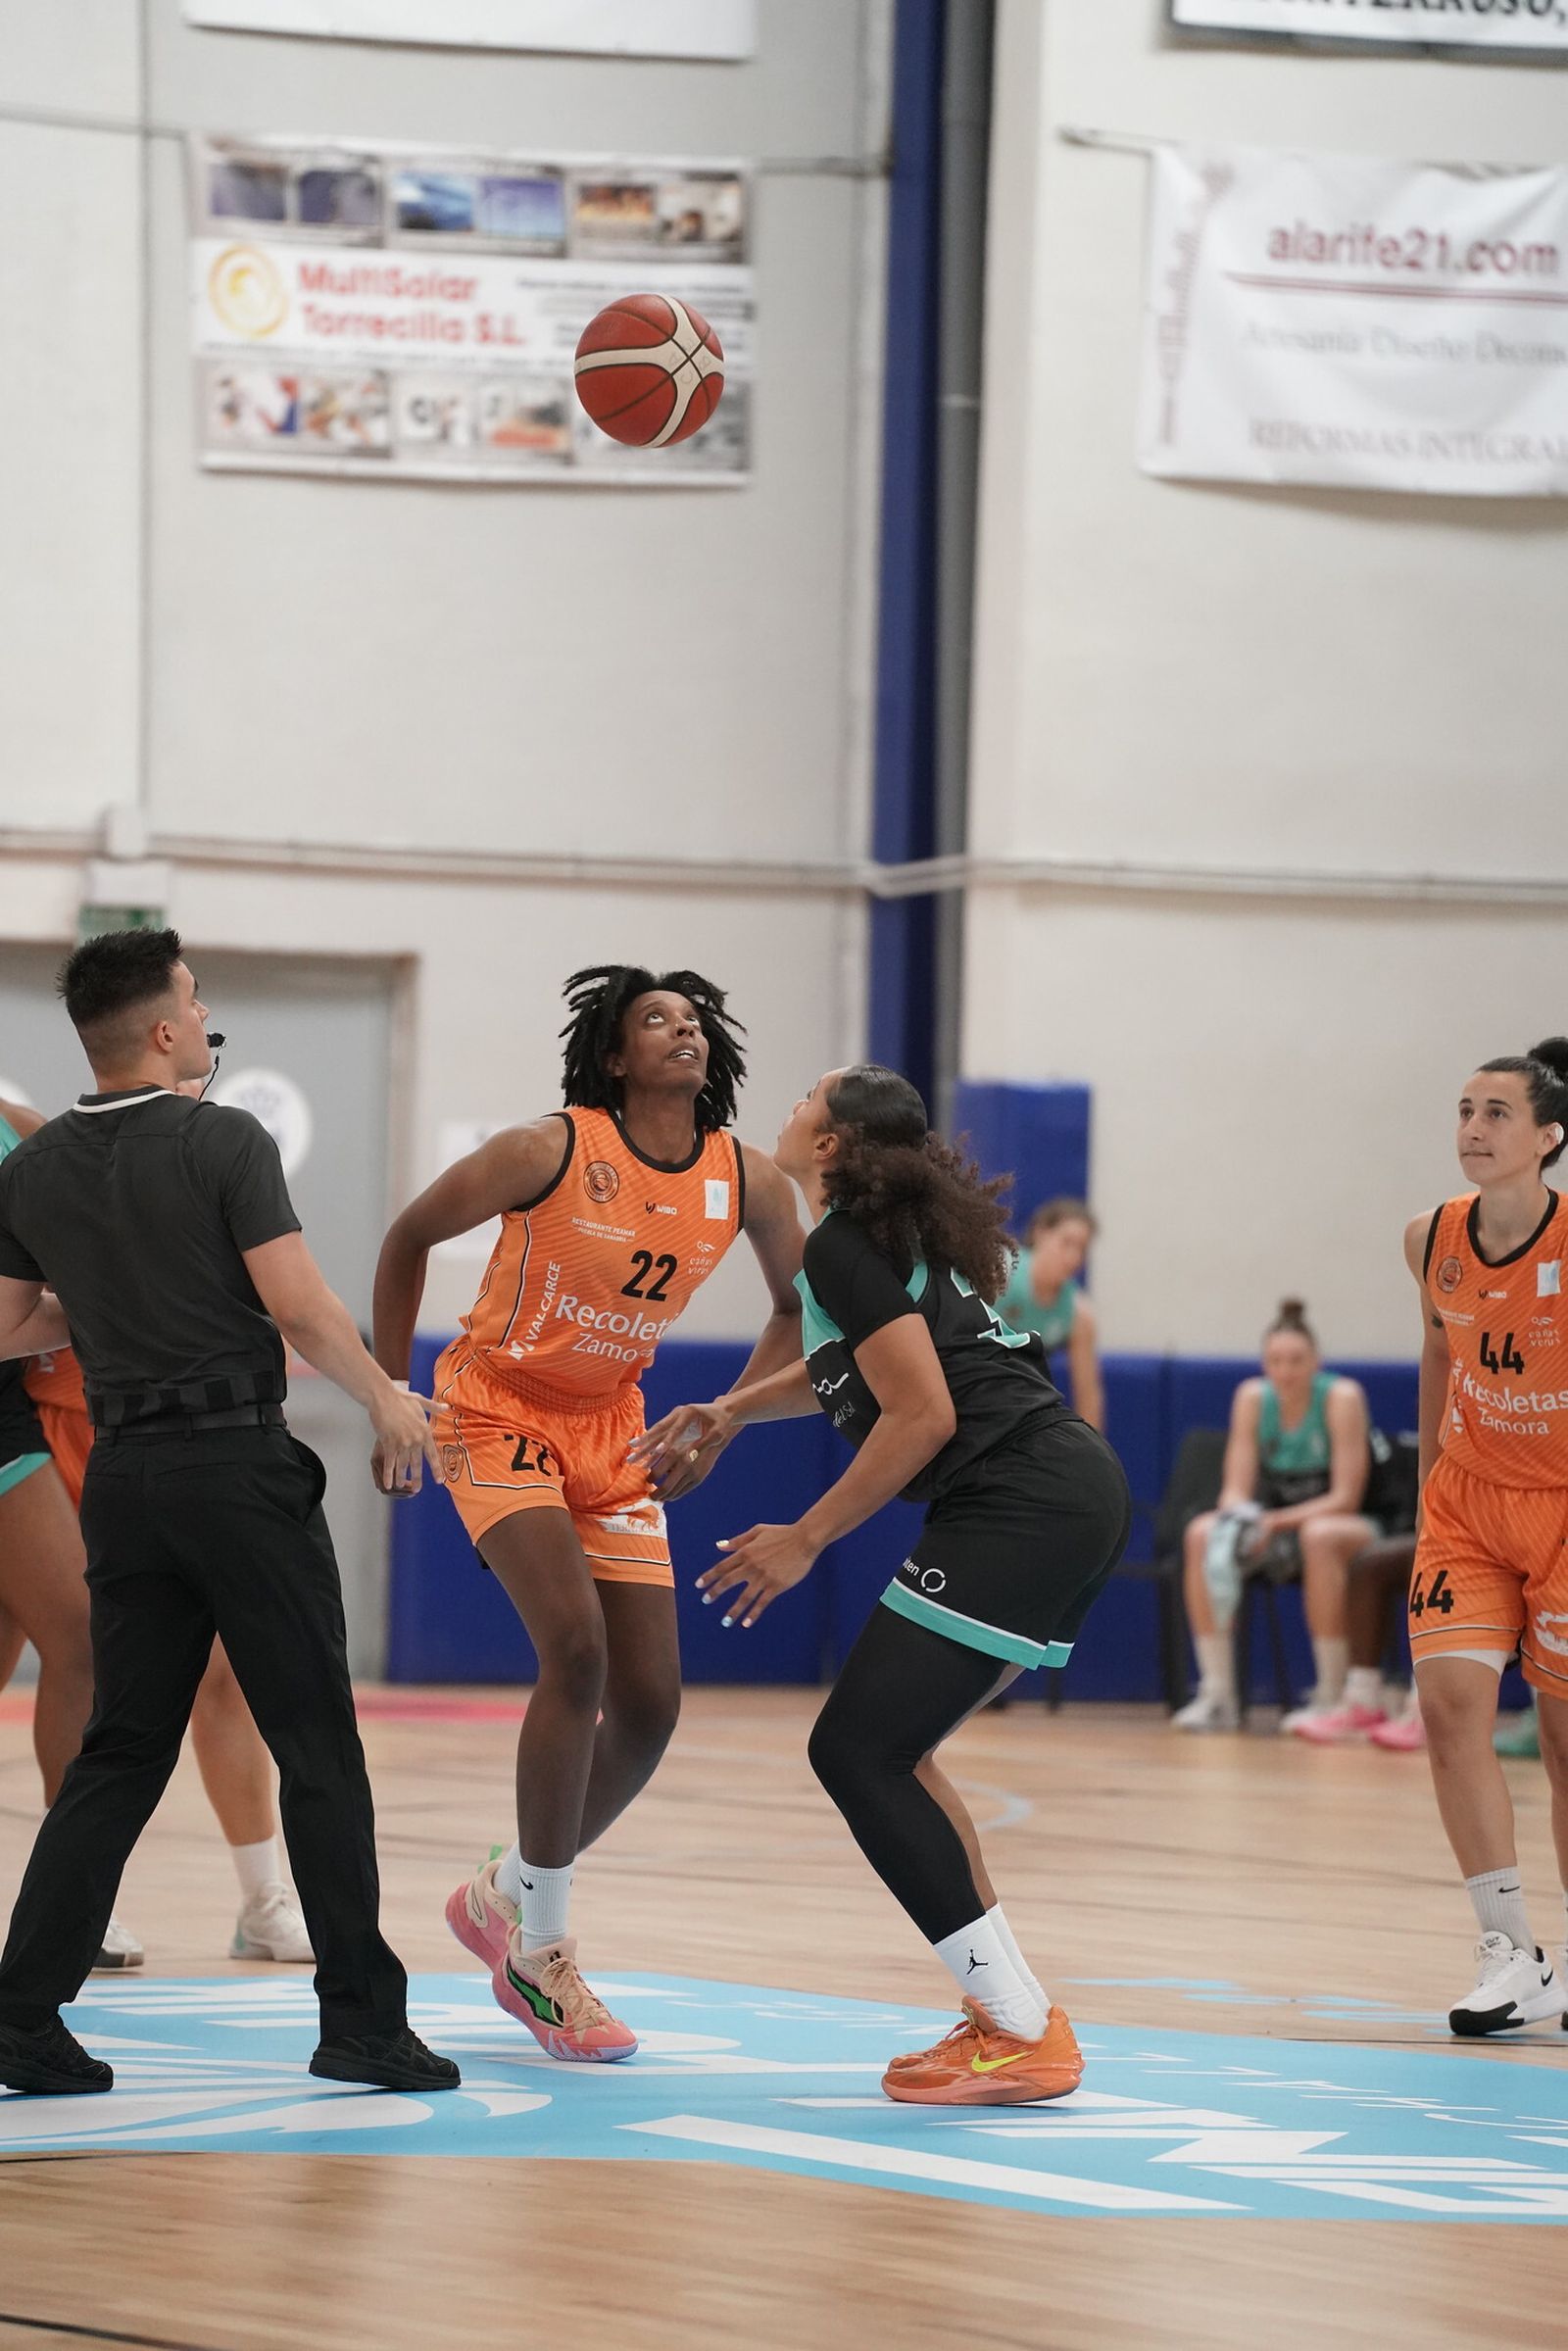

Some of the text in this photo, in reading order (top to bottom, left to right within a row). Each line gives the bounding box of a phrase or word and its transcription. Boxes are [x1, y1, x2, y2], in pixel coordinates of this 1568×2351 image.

[1268, 221, 1560, 275] alarife21.com
[620, 1249, 678, 1301] 22
[525, 1261, 561, 1342] VALCARCE
[1480, 1332, 1525, 1375] 44
[1463, 1372, 1568, 1414] Recoletas
[1478, 1406, 1549, 1435] Zamora
[1409, 1570, 1454, 1618] 44
